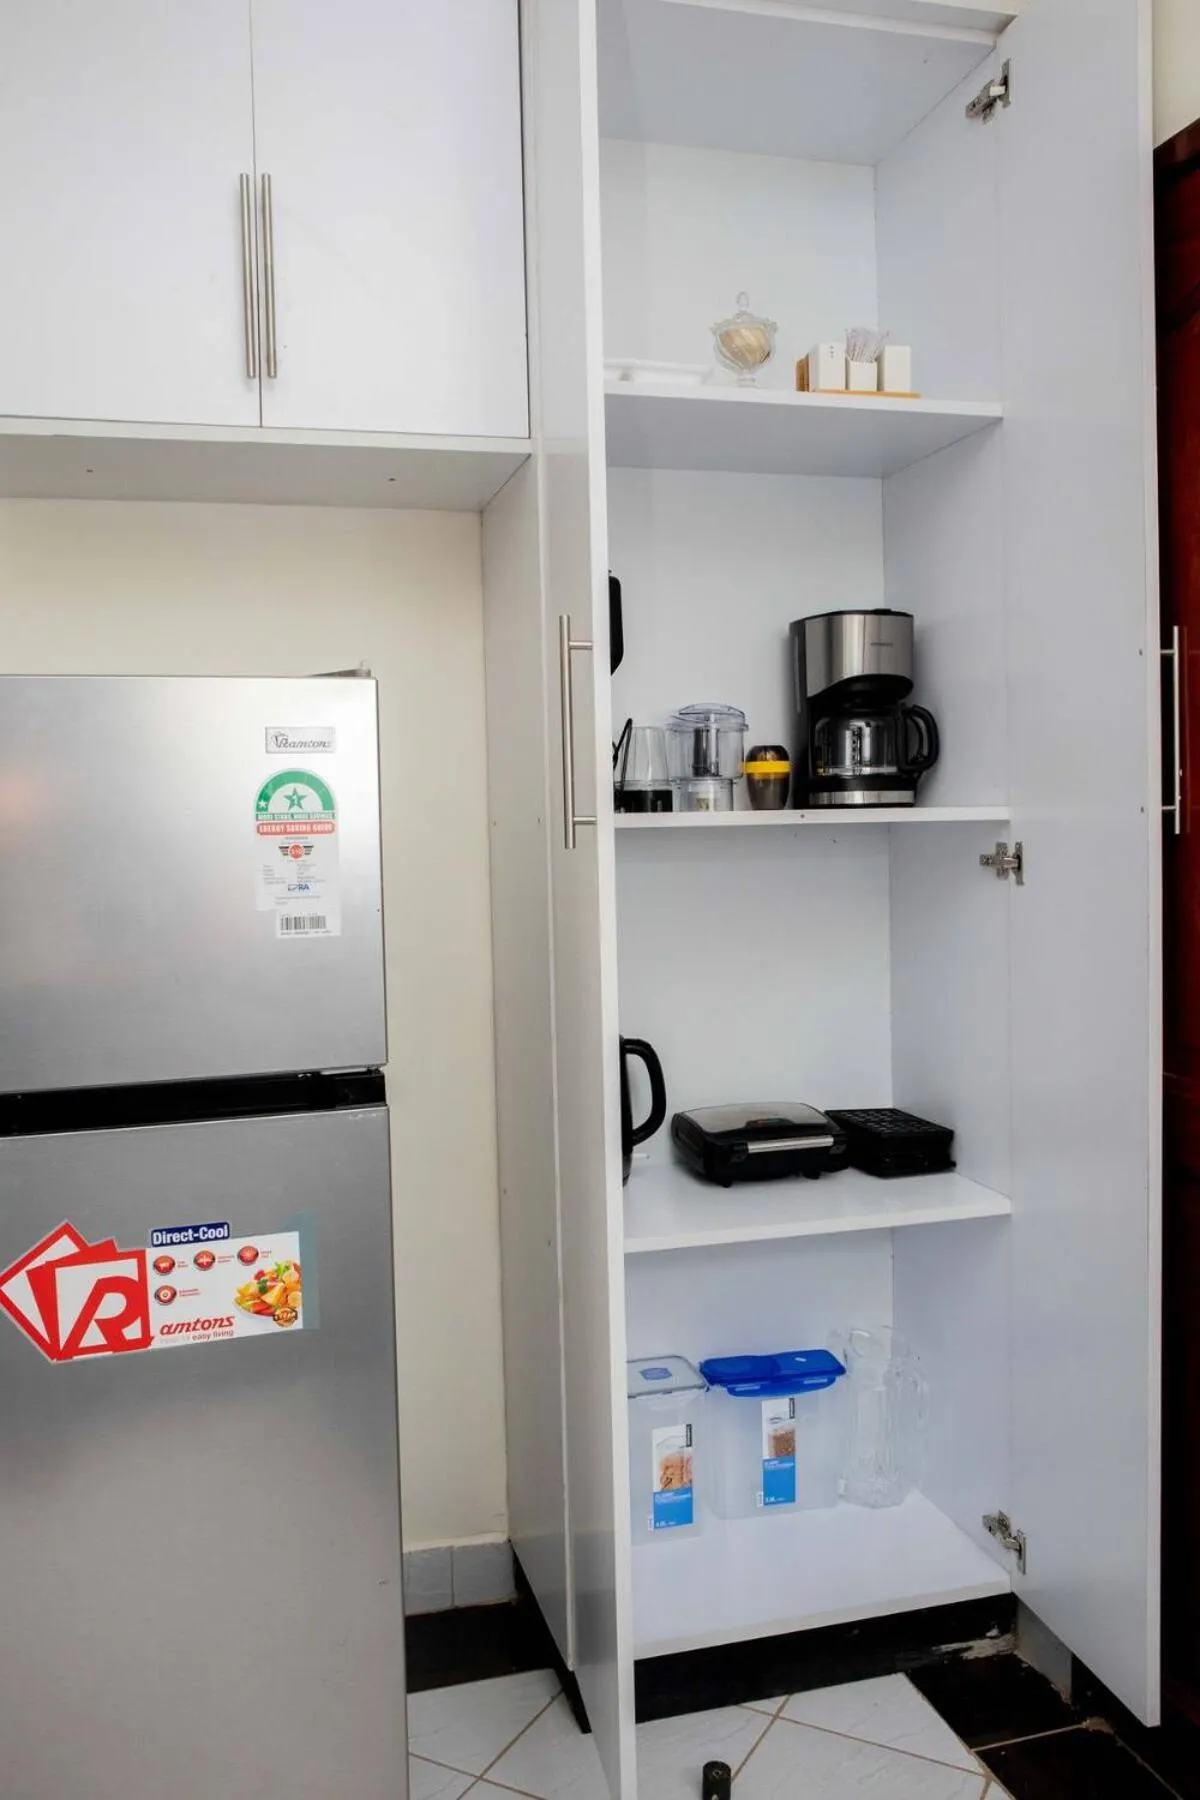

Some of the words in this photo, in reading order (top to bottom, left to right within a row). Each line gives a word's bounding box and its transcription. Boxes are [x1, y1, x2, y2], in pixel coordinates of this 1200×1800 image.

[152, 1225, 228, 1245] Direct-Cool
[192, 1333, 211, 1342] easy
[213, 1329, 235, 1339] living
